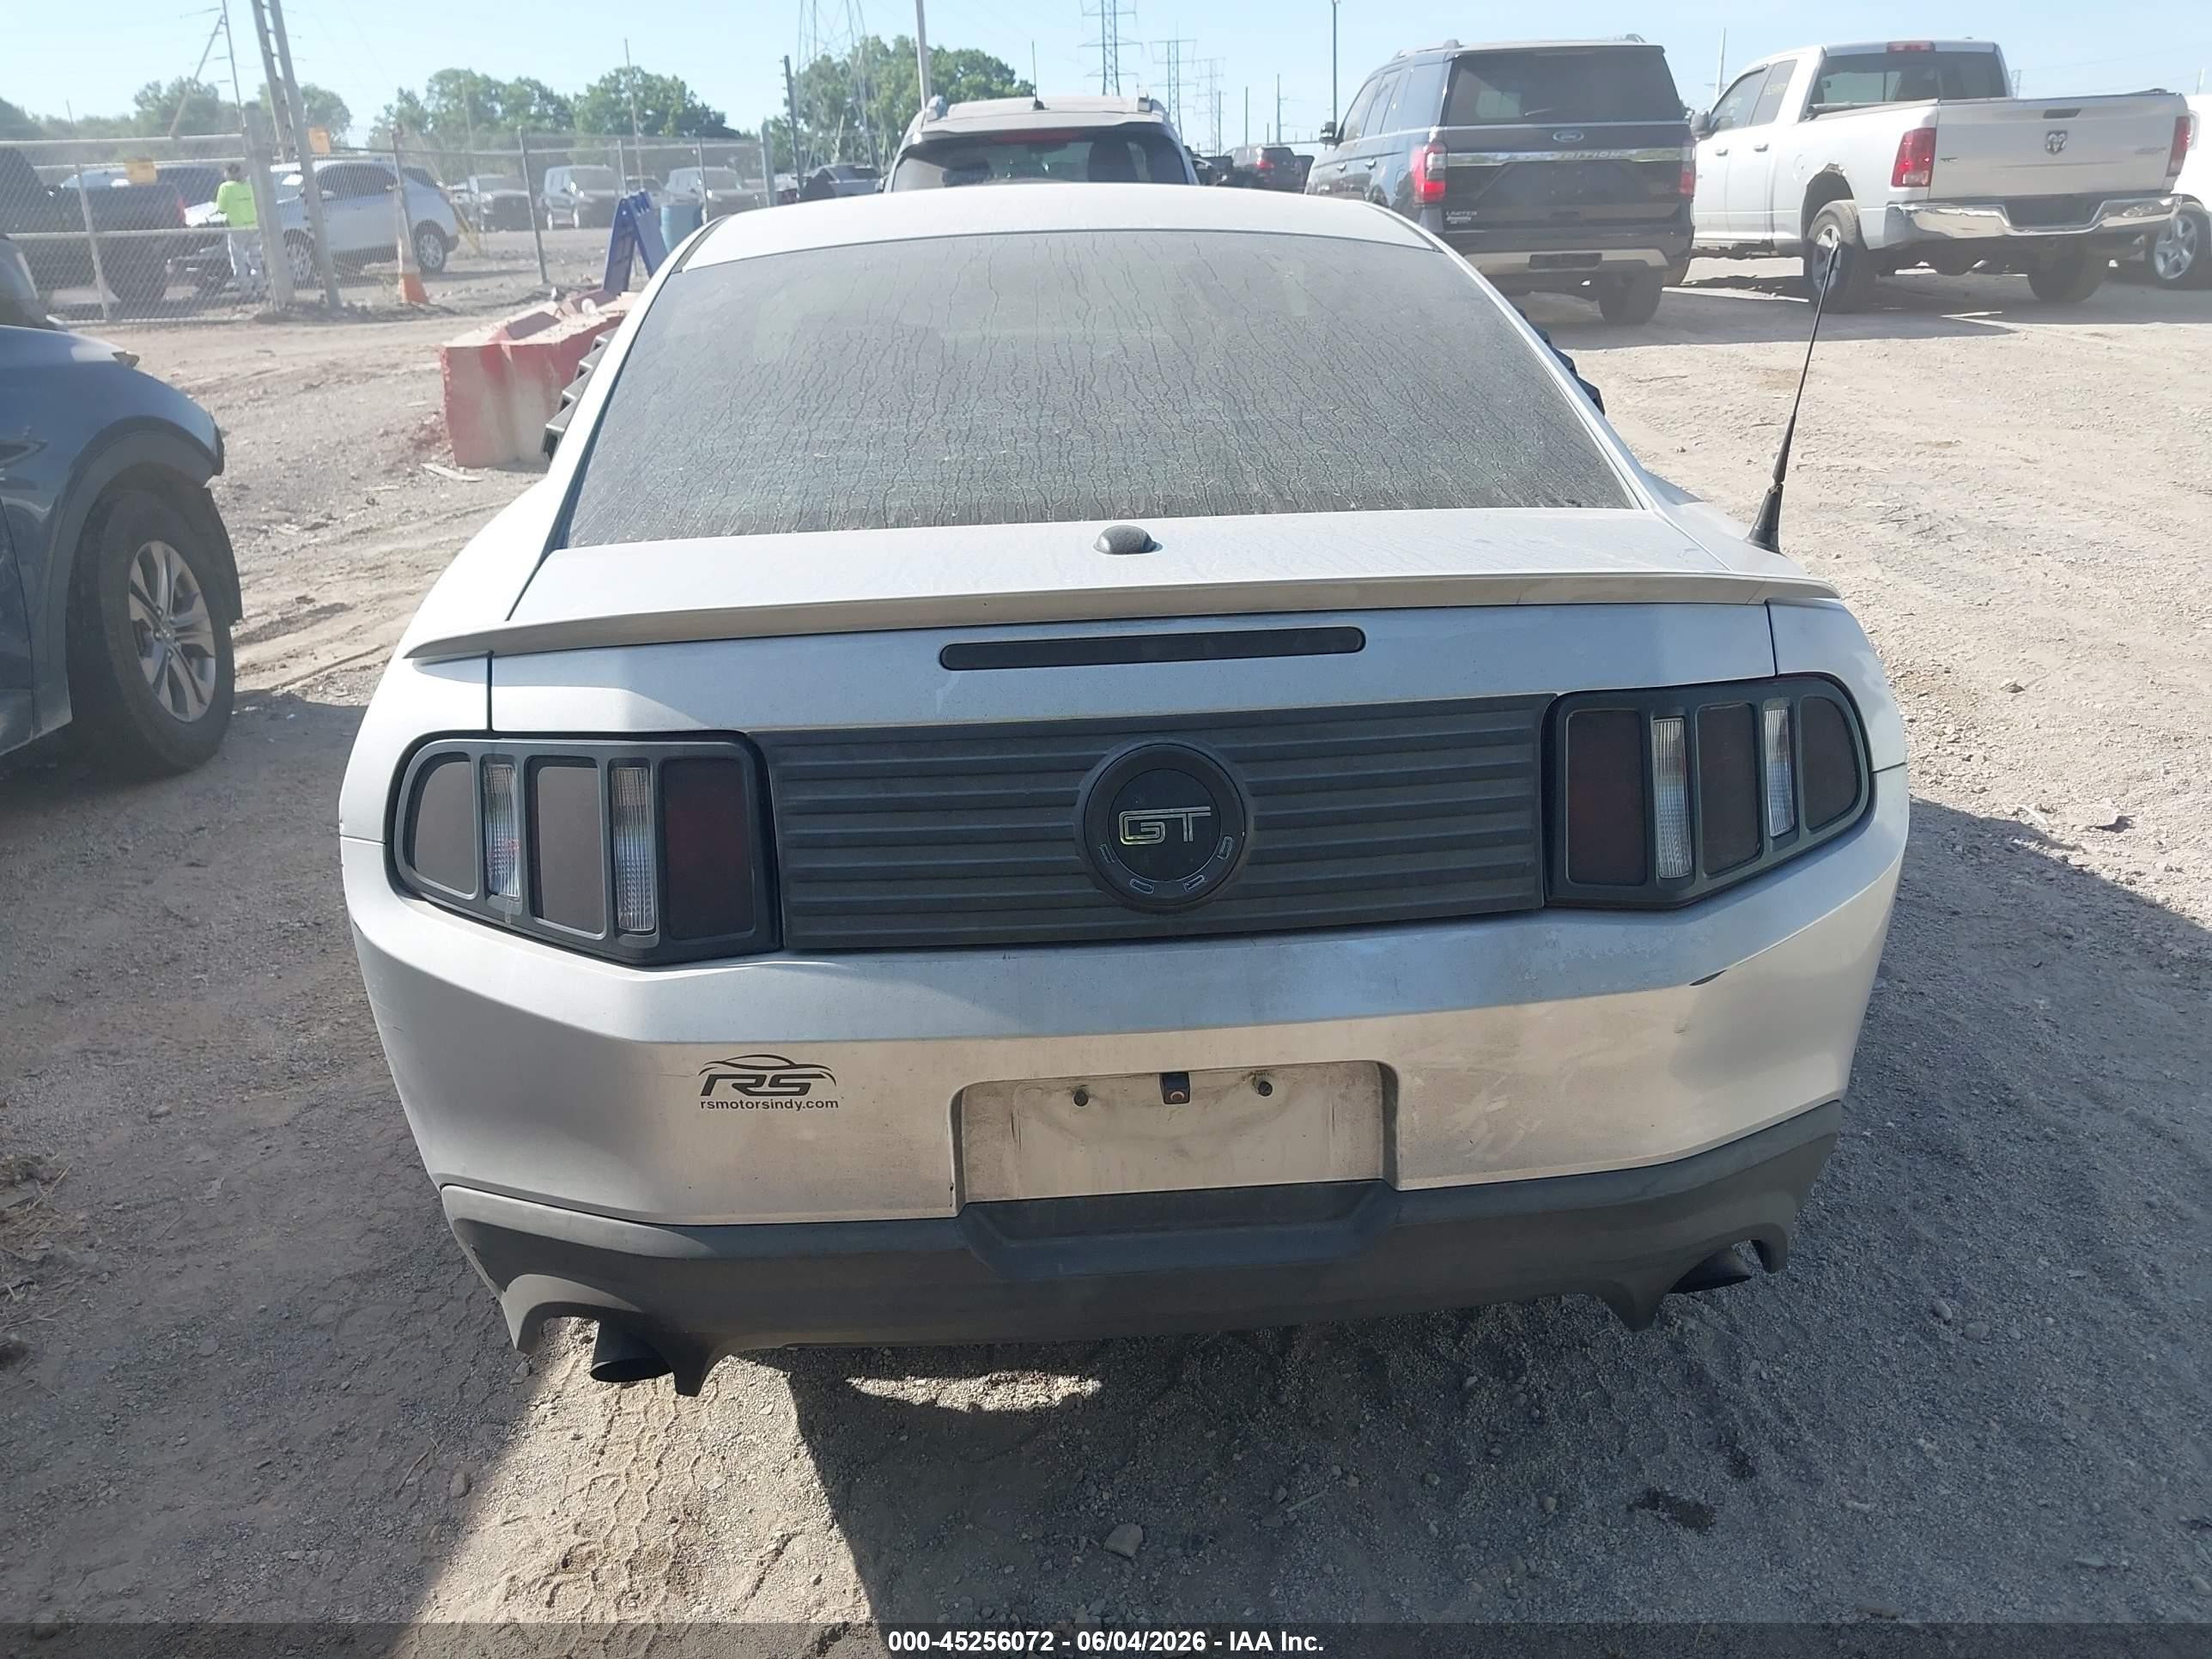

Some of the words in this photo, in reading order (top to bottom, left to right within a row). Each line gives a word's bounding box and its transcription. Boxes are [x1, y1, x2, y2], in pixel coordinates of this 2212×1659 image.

[1119, 806, 1211, 845] GT
[701, 1074, 827, 1097] RS
[701, 1099, 838, 1111] rsmotorsindy.com
